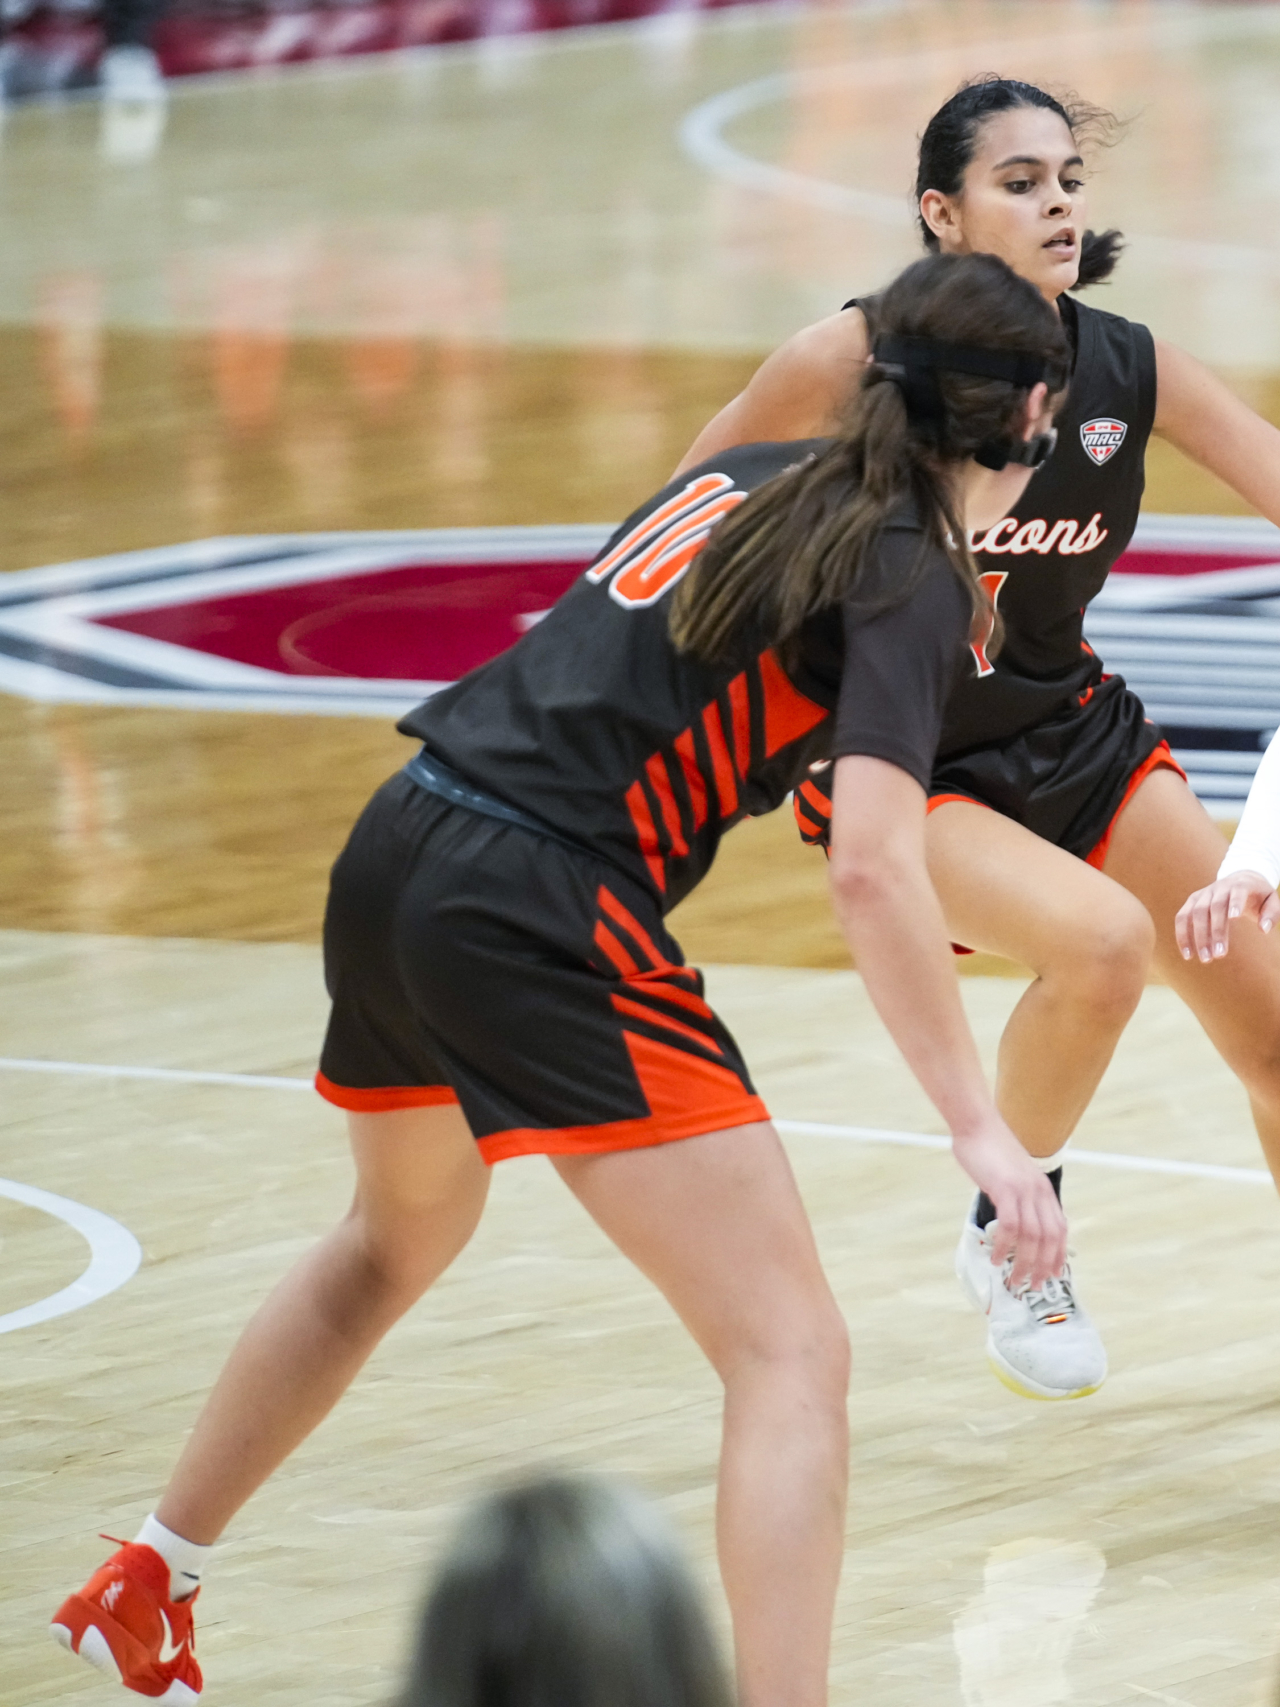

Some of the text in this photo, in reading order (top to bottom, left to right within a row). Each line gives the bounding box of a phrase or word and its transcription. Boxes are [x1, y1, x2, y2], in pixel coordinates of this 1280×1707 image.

[1084, 433, 1122, 446] MAC
[584, 472, 749, 610] 10
[947, 512, 1109, 555] cons
